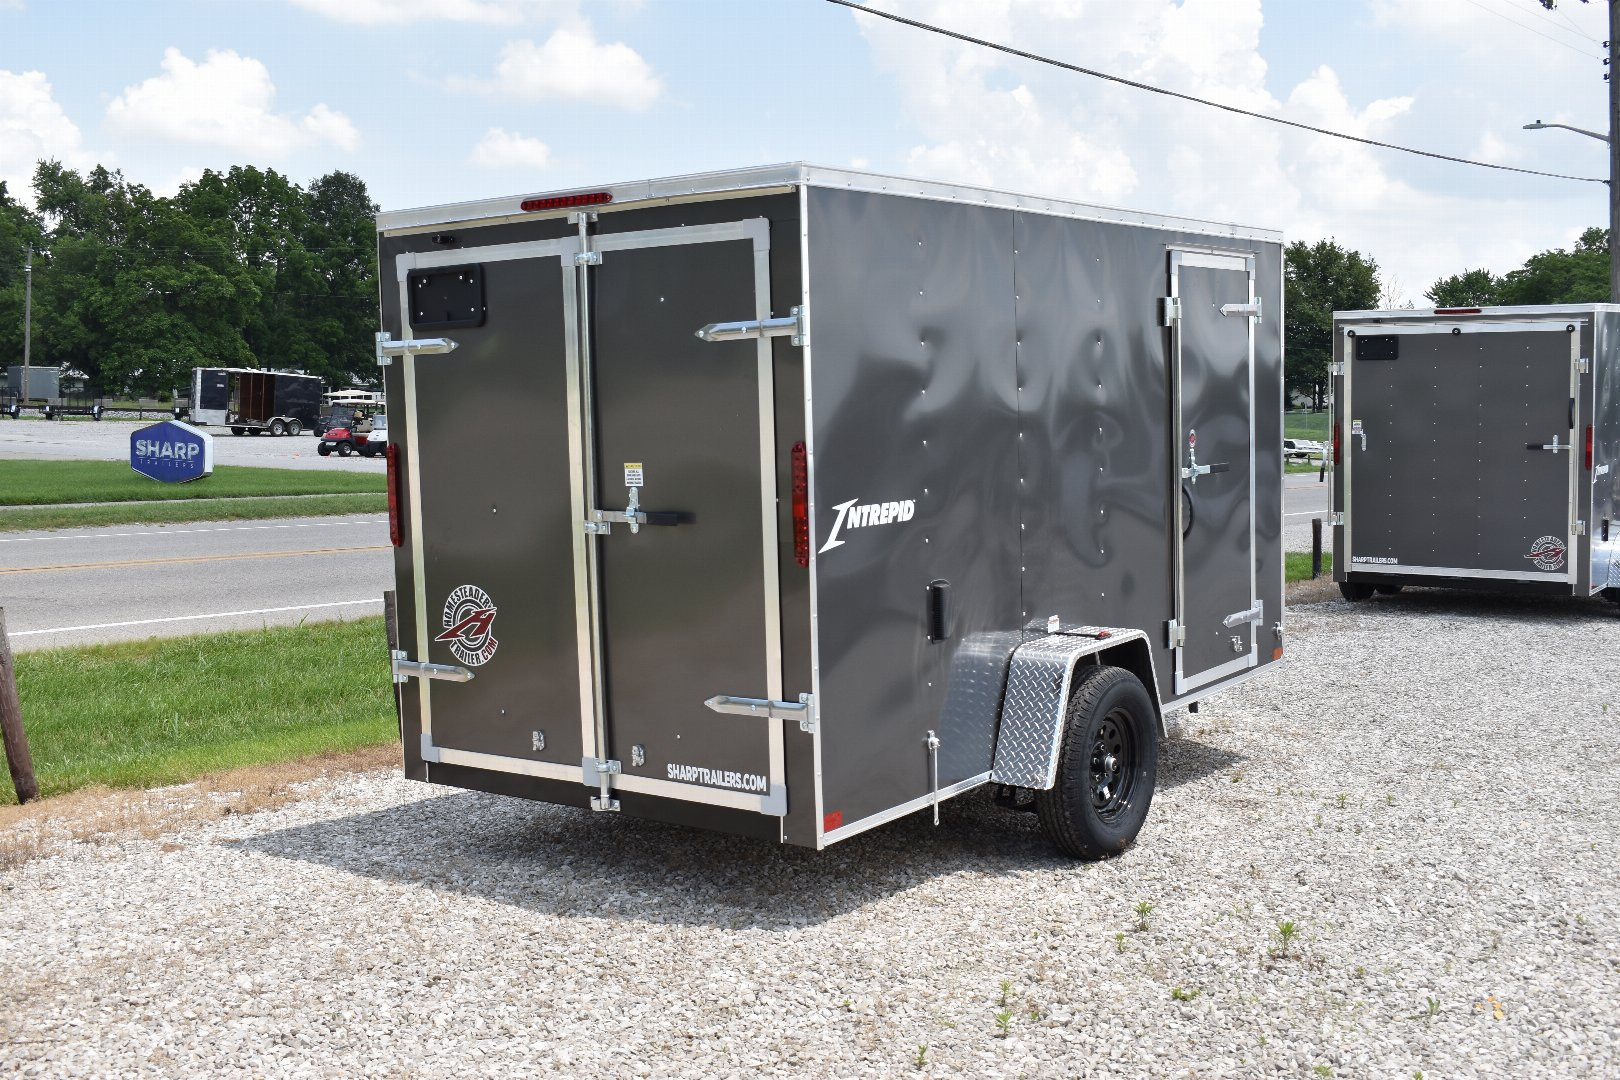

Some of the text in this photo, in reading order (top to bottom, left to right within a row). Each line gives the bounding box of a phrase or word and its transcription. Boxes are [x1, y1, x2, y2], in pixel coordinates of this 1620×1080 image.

[135, 439, 200, 460] SHARP
[818, 498, 915, 554] INTREPID
[443, 585, 493, 628] HOMESTEADER
[450, 636, 498, 667] TRAILER.COM
[667, 763, 767, 792] SHARPTRAILERS.COM
